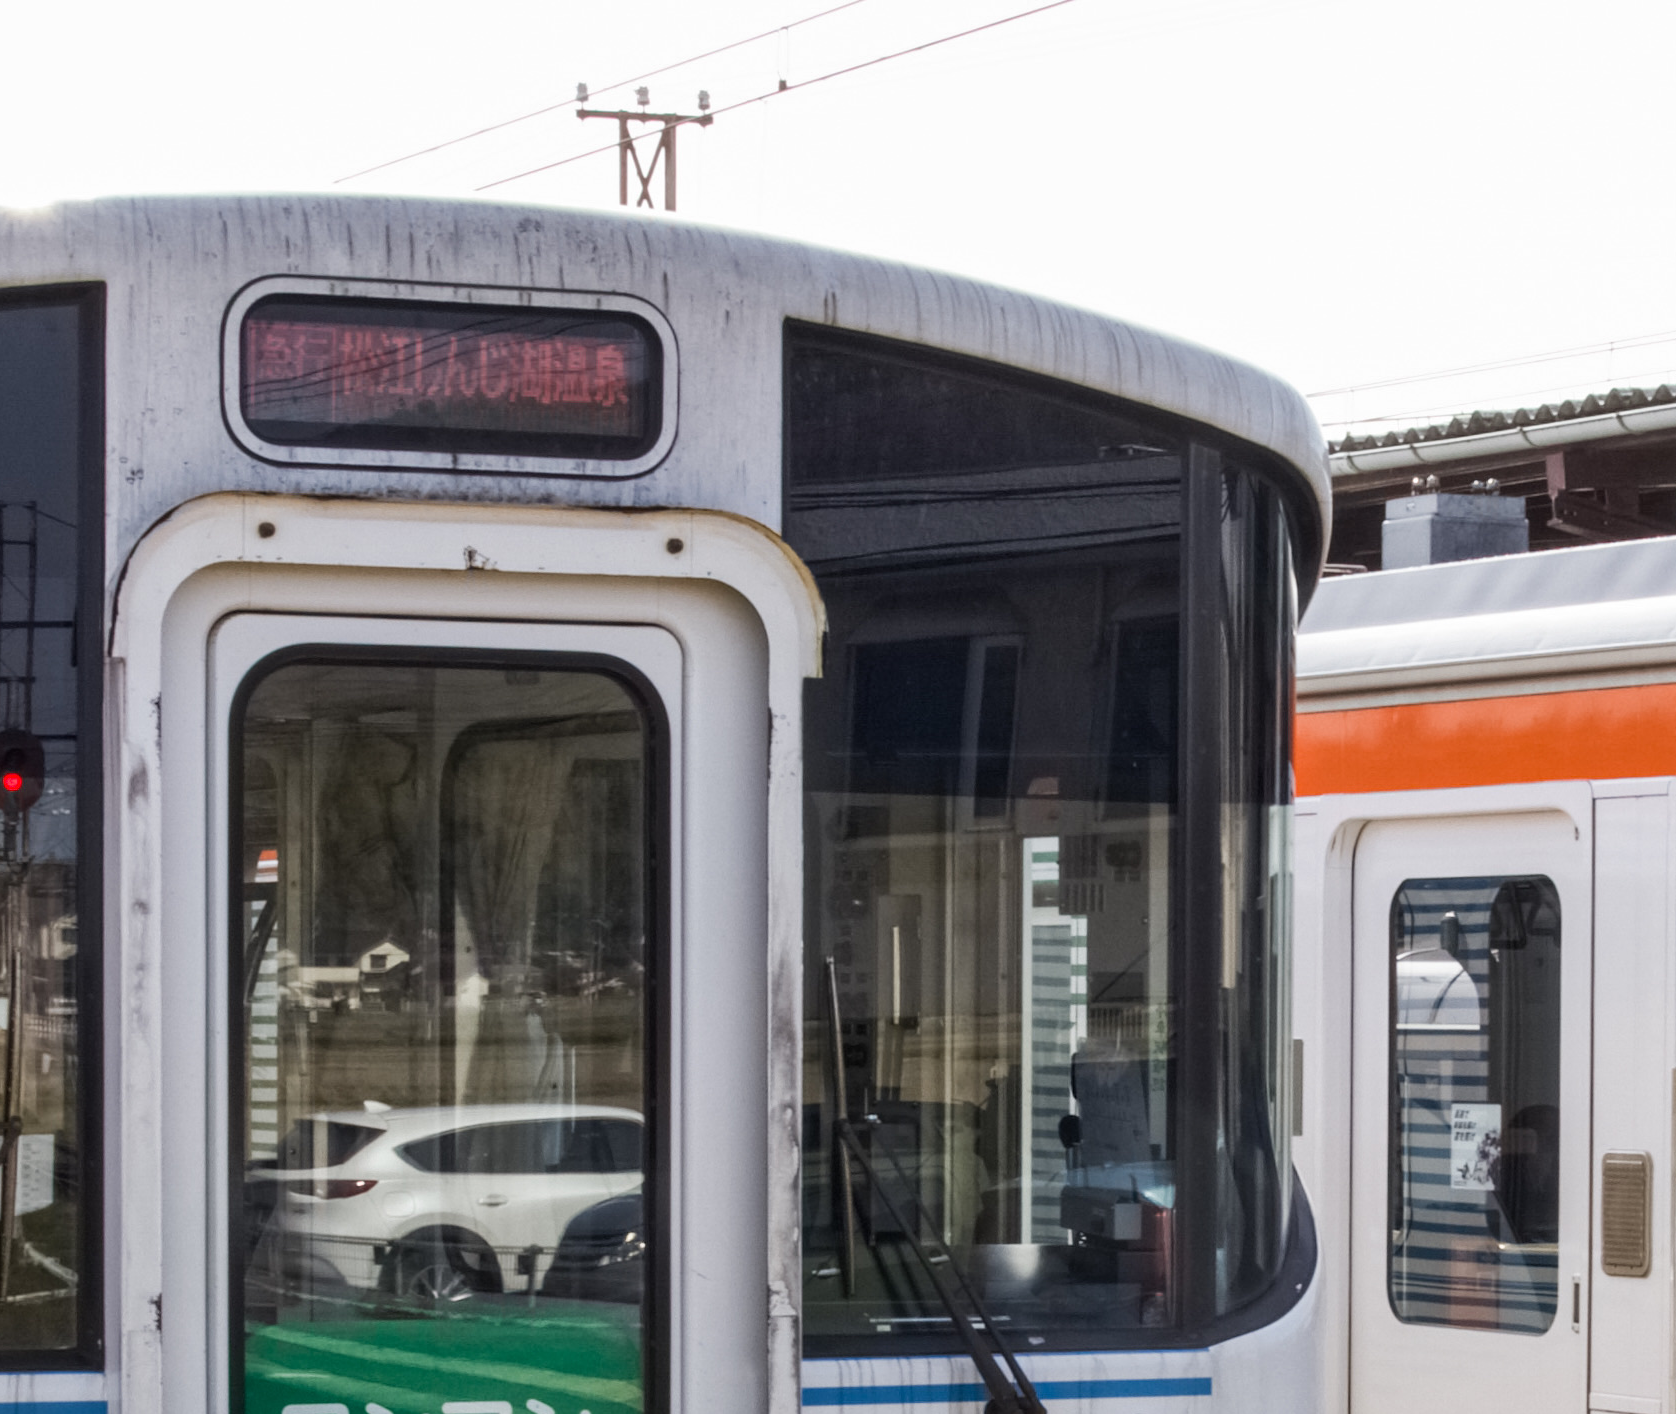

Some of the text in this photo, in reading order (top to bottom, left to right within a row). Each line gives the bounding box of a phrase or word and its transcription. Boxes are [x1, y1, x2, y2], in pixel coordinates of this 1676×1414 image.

[341, 331, 628, 407] 松江しんじ湖温泉
